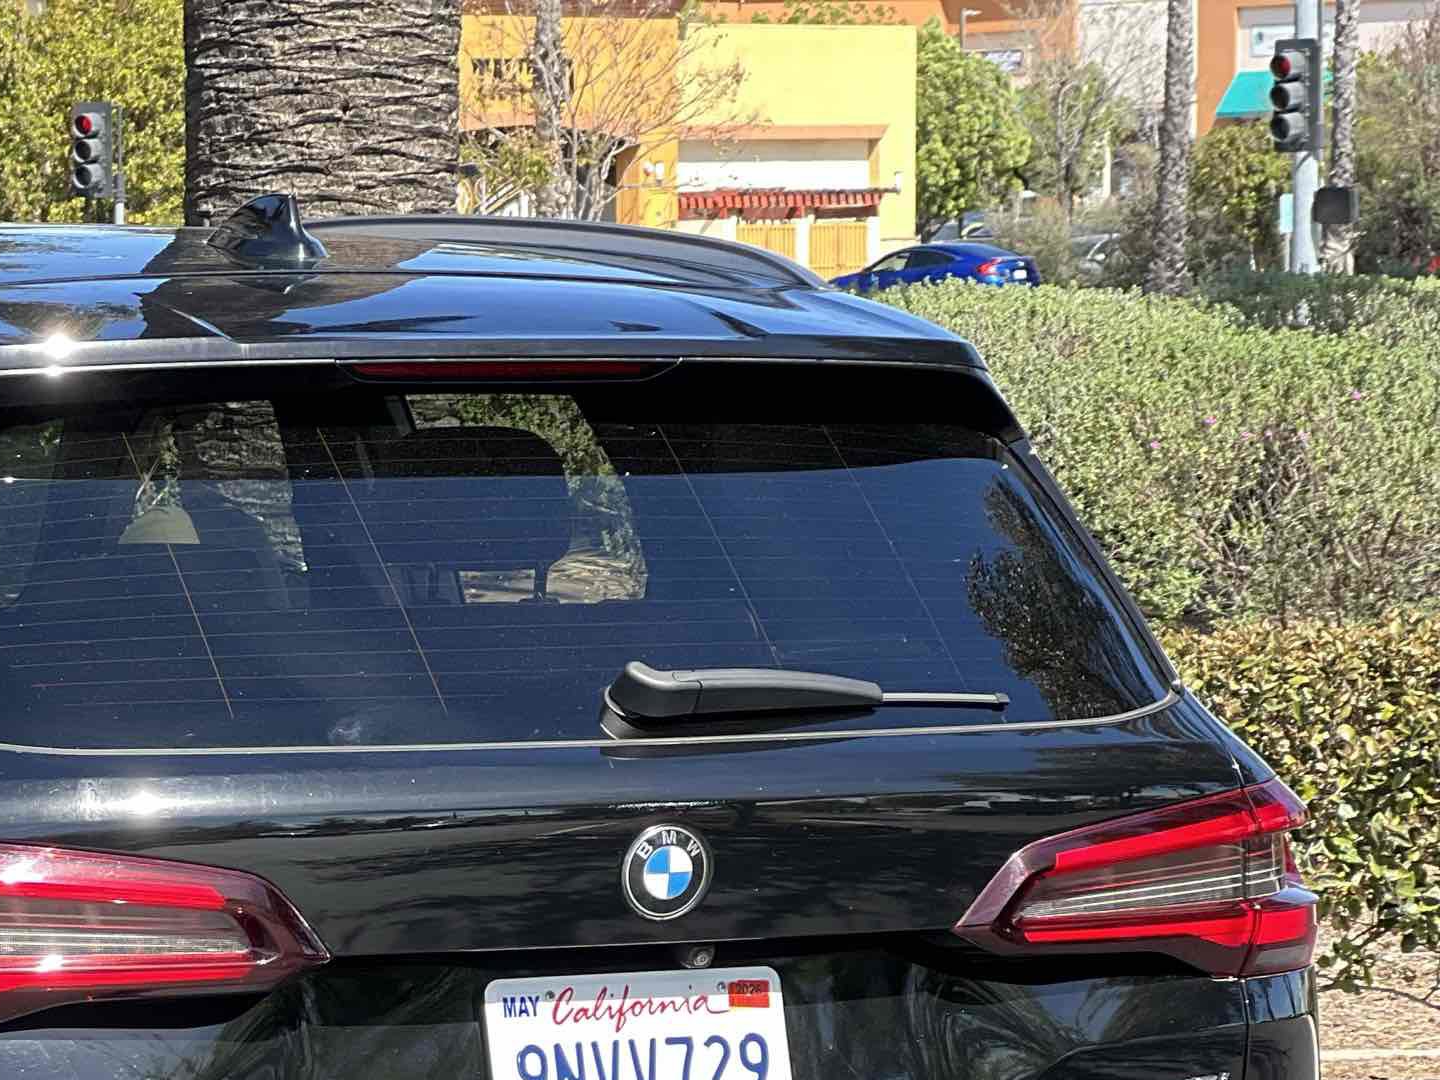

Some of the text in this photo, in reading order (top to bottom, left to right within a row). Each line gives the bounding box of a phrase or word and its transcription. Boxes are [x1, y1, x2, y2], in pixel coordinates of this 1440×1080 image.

[636, 830, 701, 860] BMW
[502, 995, 540, 1019] MAY
[551, 984, 729, 1033] California
